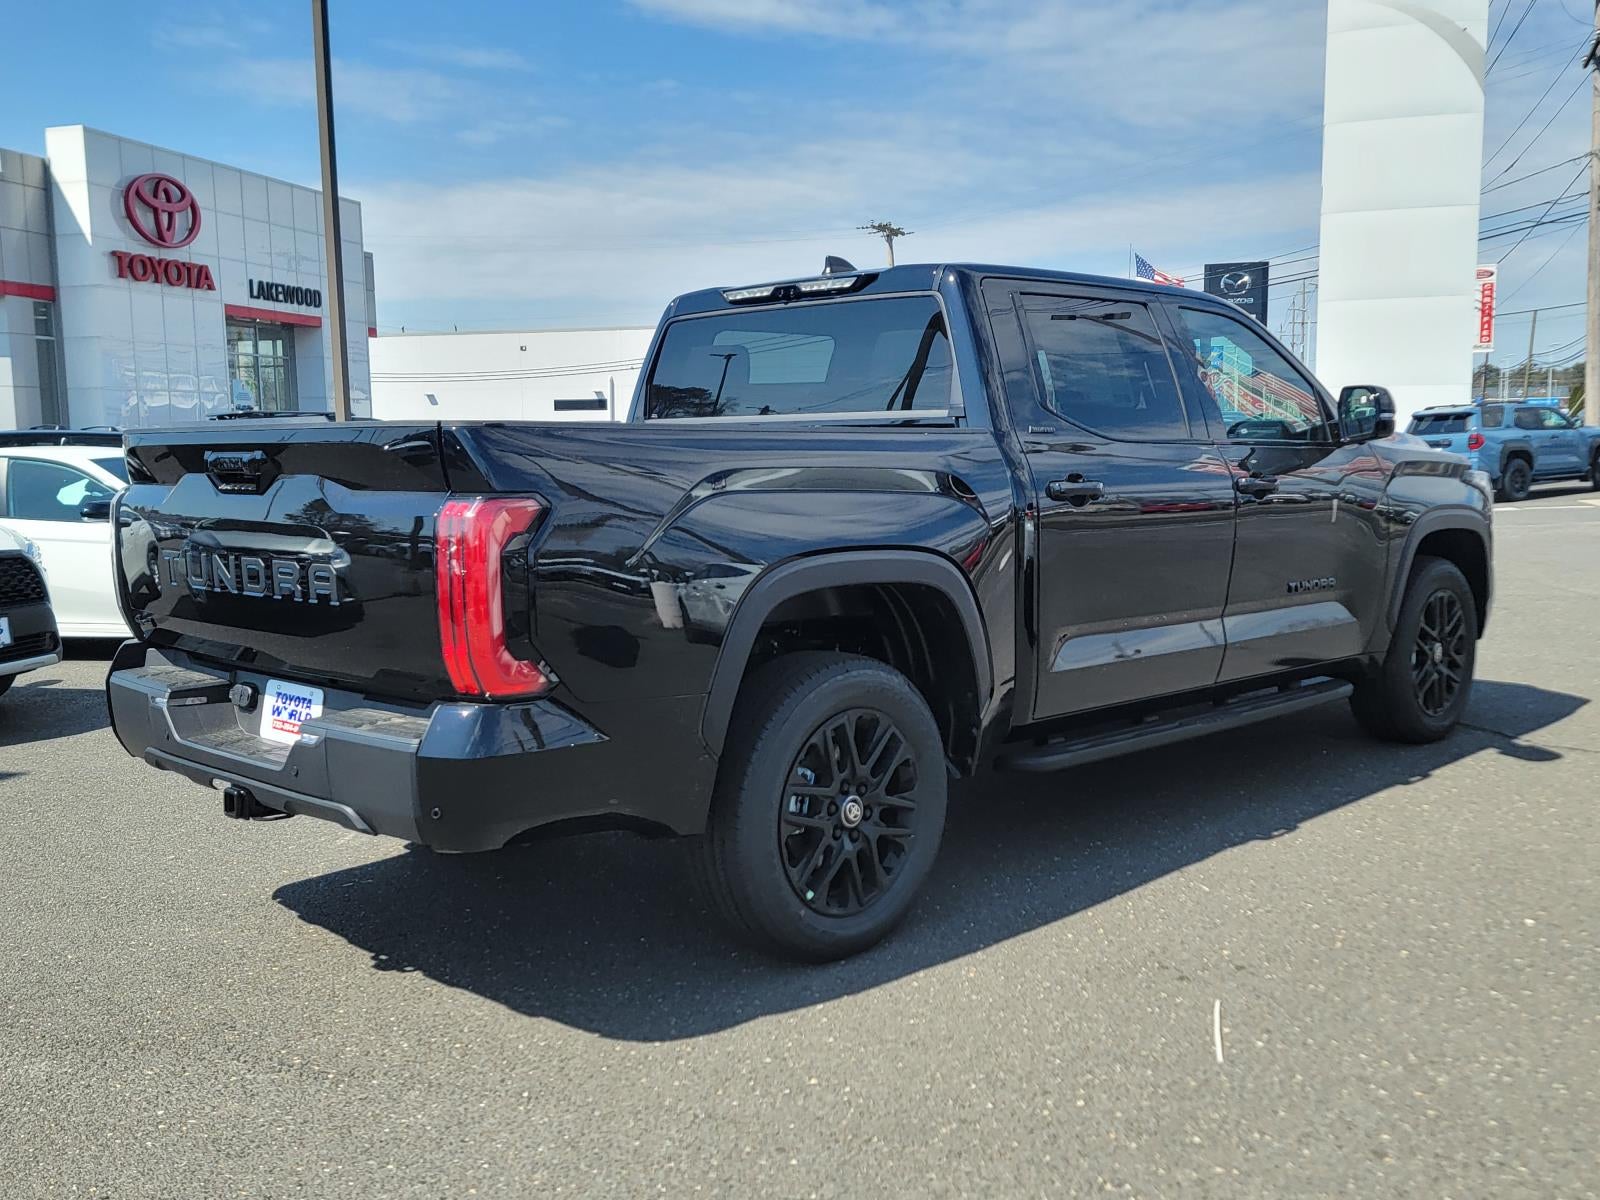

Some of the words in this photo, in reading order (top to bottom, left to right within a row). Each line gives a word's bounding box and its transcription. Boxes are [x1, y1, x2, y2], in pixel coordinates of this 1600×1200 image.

[111, 250, 216, 291] TOYOTA
[249, 279, 322, 308] LAKEWOOD
[161, 550, 340, 606] TUNDRA
[1287, 577, 1336, 593] TUNDRA
[275, 691, 313, 710] TOYOTA
